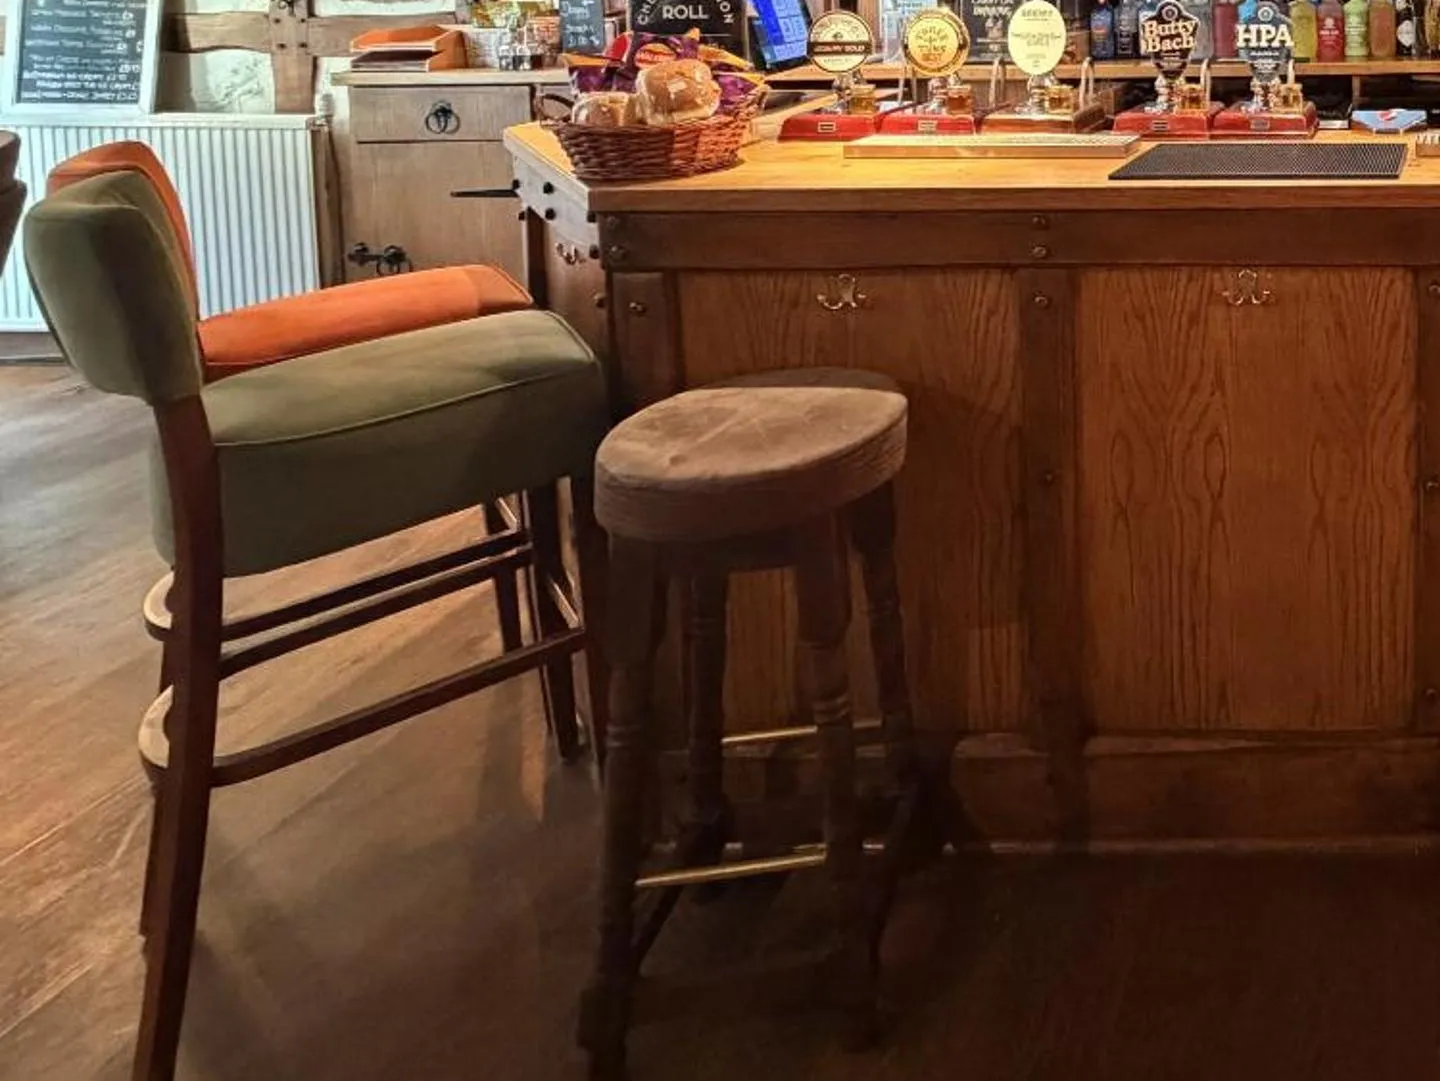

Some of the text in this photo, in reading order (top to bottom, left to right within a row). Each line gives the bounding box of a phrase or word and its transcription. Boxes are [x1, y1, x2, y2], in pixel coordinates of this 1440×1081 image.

[662, 4, 710, 20] ROLL
[1143, 19, 1196, 37] Butty
[1236, 23, 1295, 48] HPA
[1147, 34, 1195, 52] Bach
